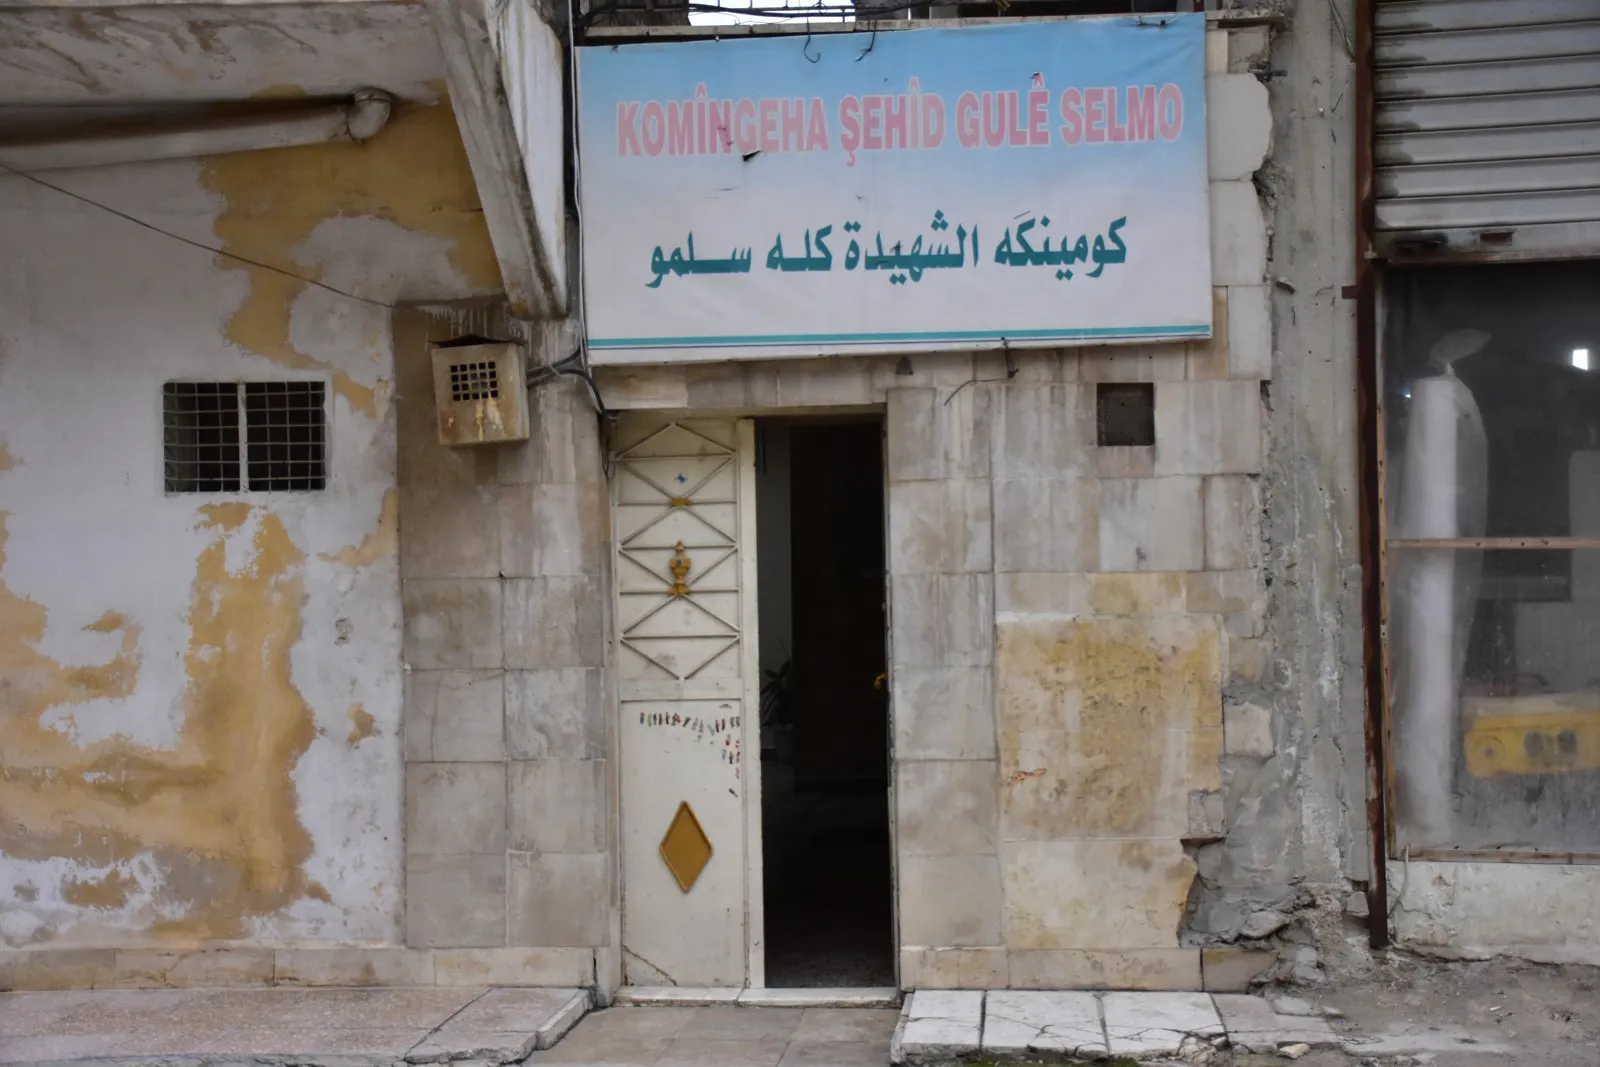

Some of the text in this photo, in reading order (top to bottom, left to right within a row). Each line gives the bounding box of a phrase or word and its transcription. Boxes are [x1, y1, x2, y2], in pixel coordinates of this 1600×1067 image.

[616, 72, 1184, 167] KOMÎNGEHA ŞEHÎD GULÊ SELMO
[644, 229, 753, 289] سلمو
[845, 209, 979, 286] الشهيدة
